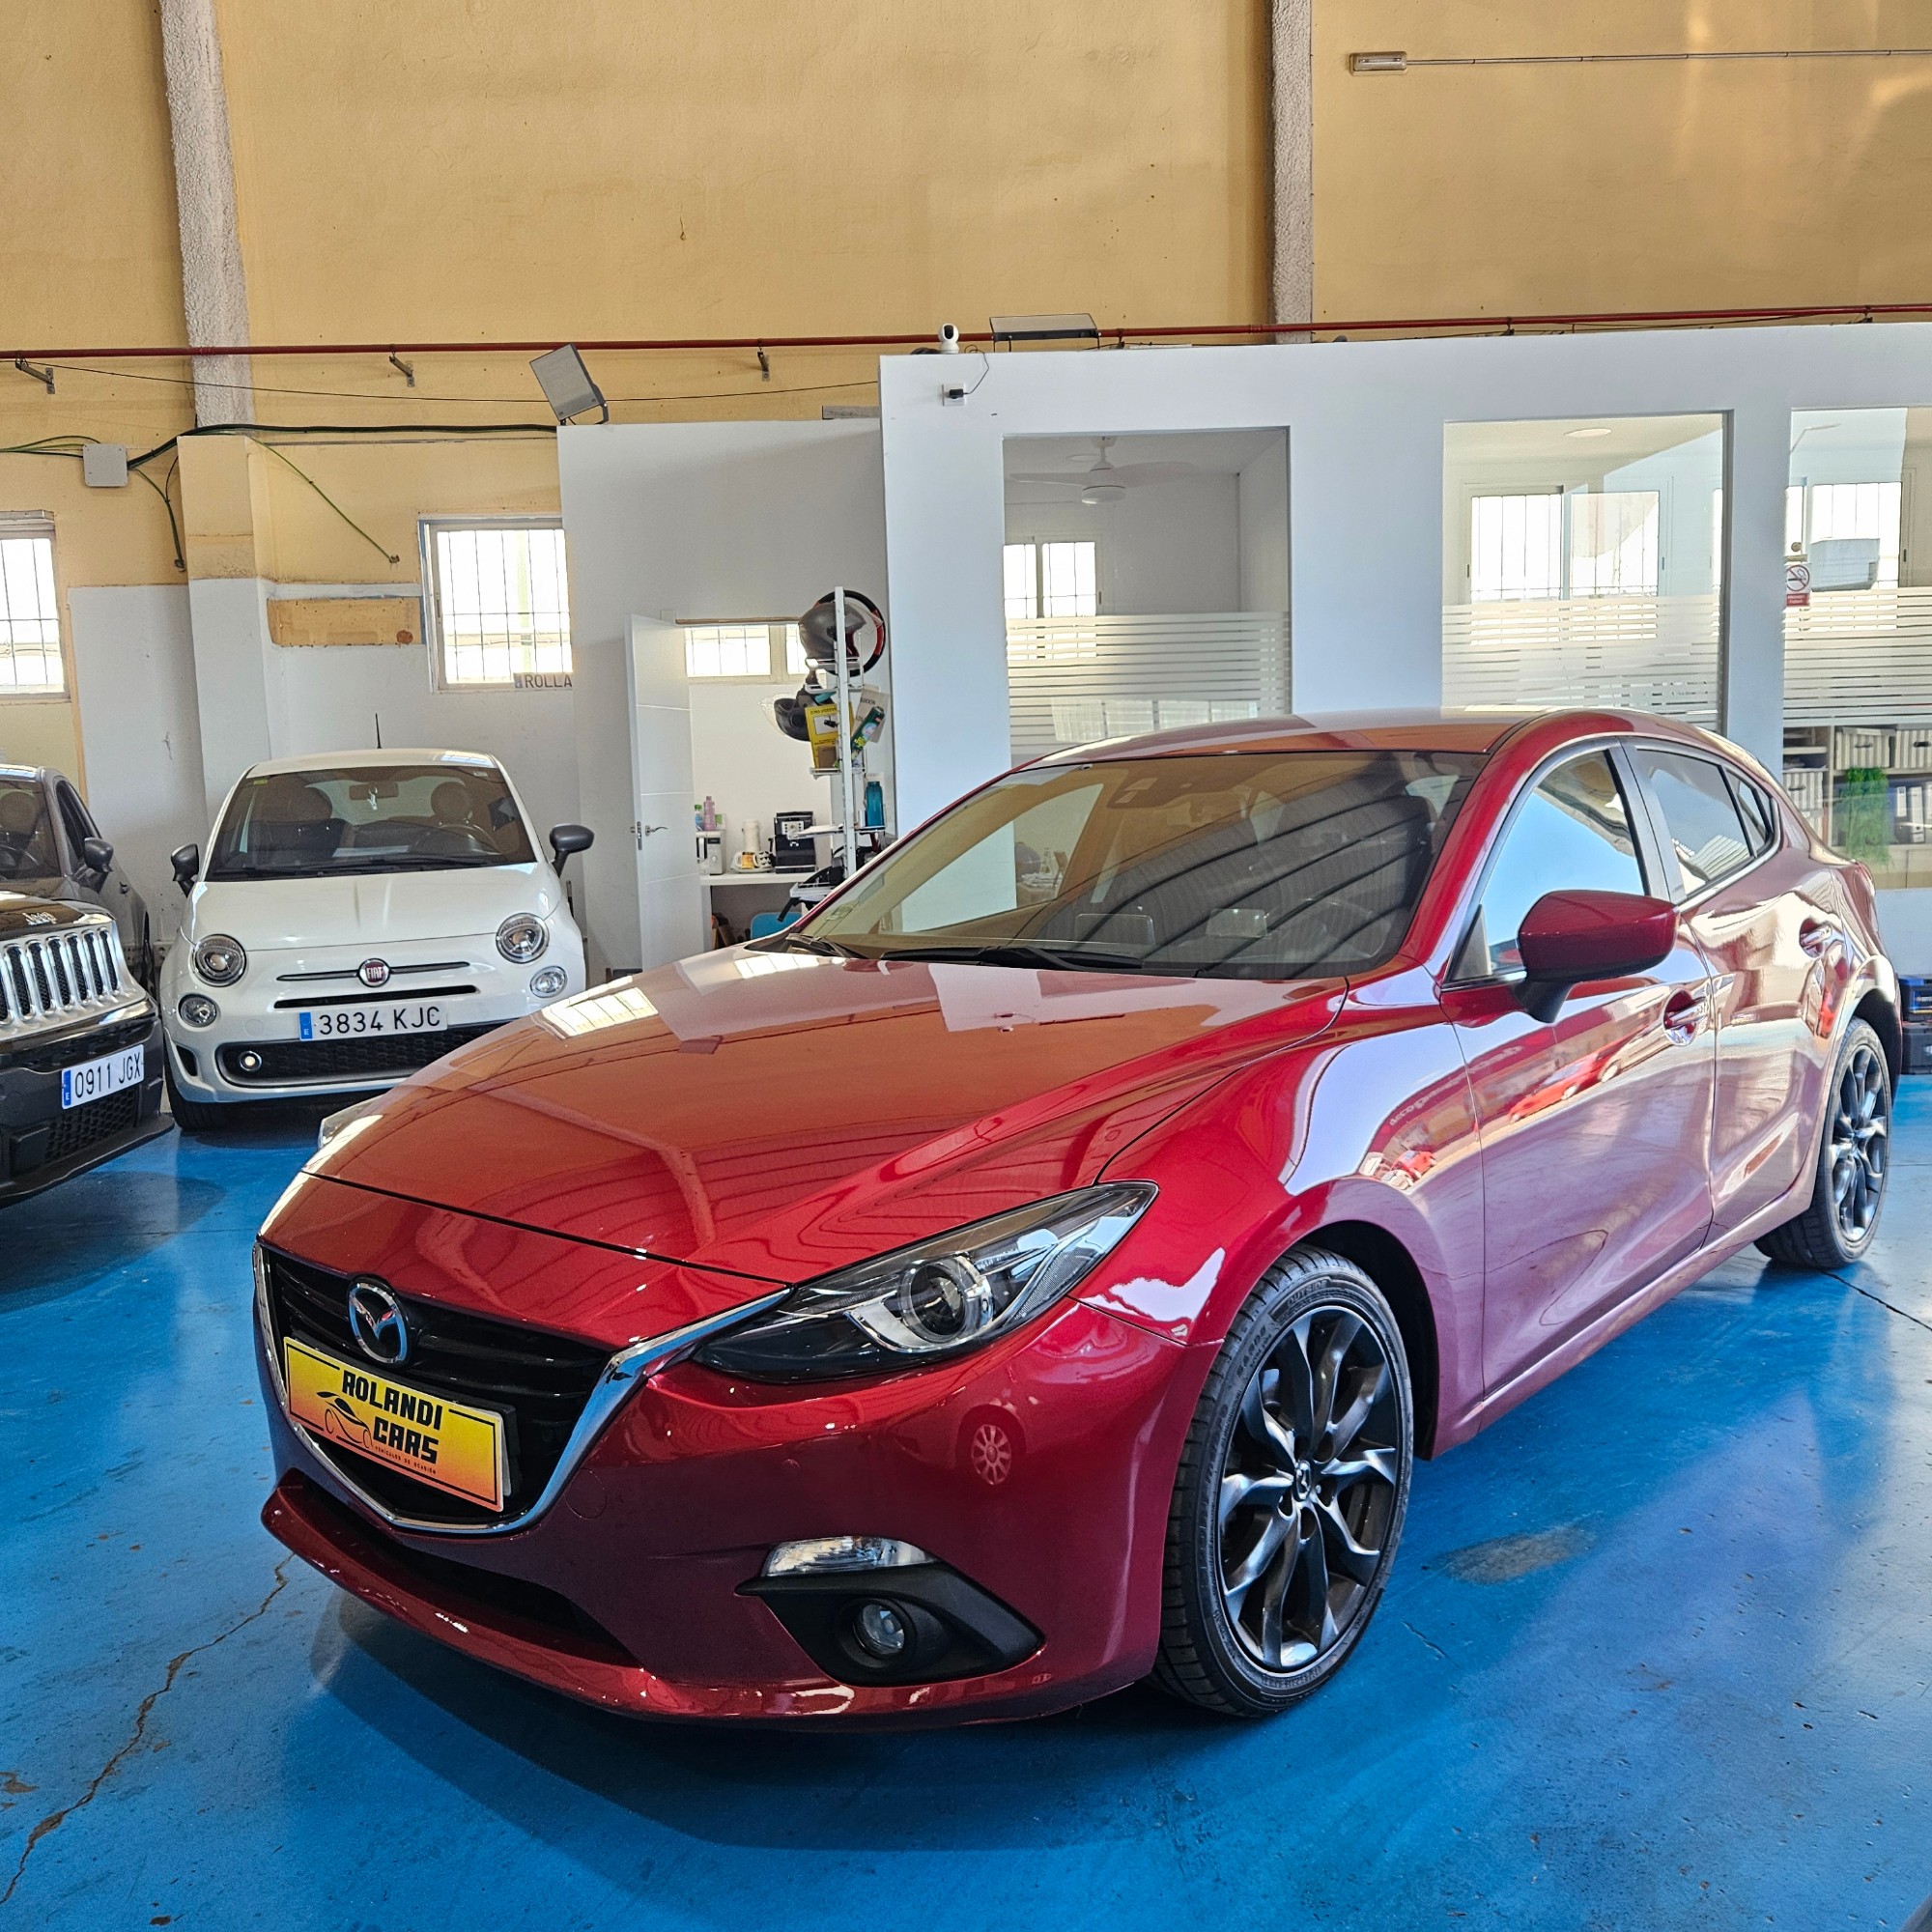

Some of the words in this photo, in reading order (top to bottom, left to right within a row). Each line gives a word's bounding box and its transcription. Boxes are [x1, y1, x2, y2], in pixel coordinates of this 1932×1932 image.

[525, 674, 573, 688] ROLLA
[366, 966, 384, 980] FIAT
[319, 1010, 384, 1036] 3834
[393, 1007, 440, 1030] KJC
[74, 1065, 111, 1098] 0911
[118, 1052, 141, 1084] JGX
[1287, 1280, 1327, 1308] OUTSIDE
[342, 1370, 443, 1431] ROLANDI
[373, 1416, 440, 1464] CARS
